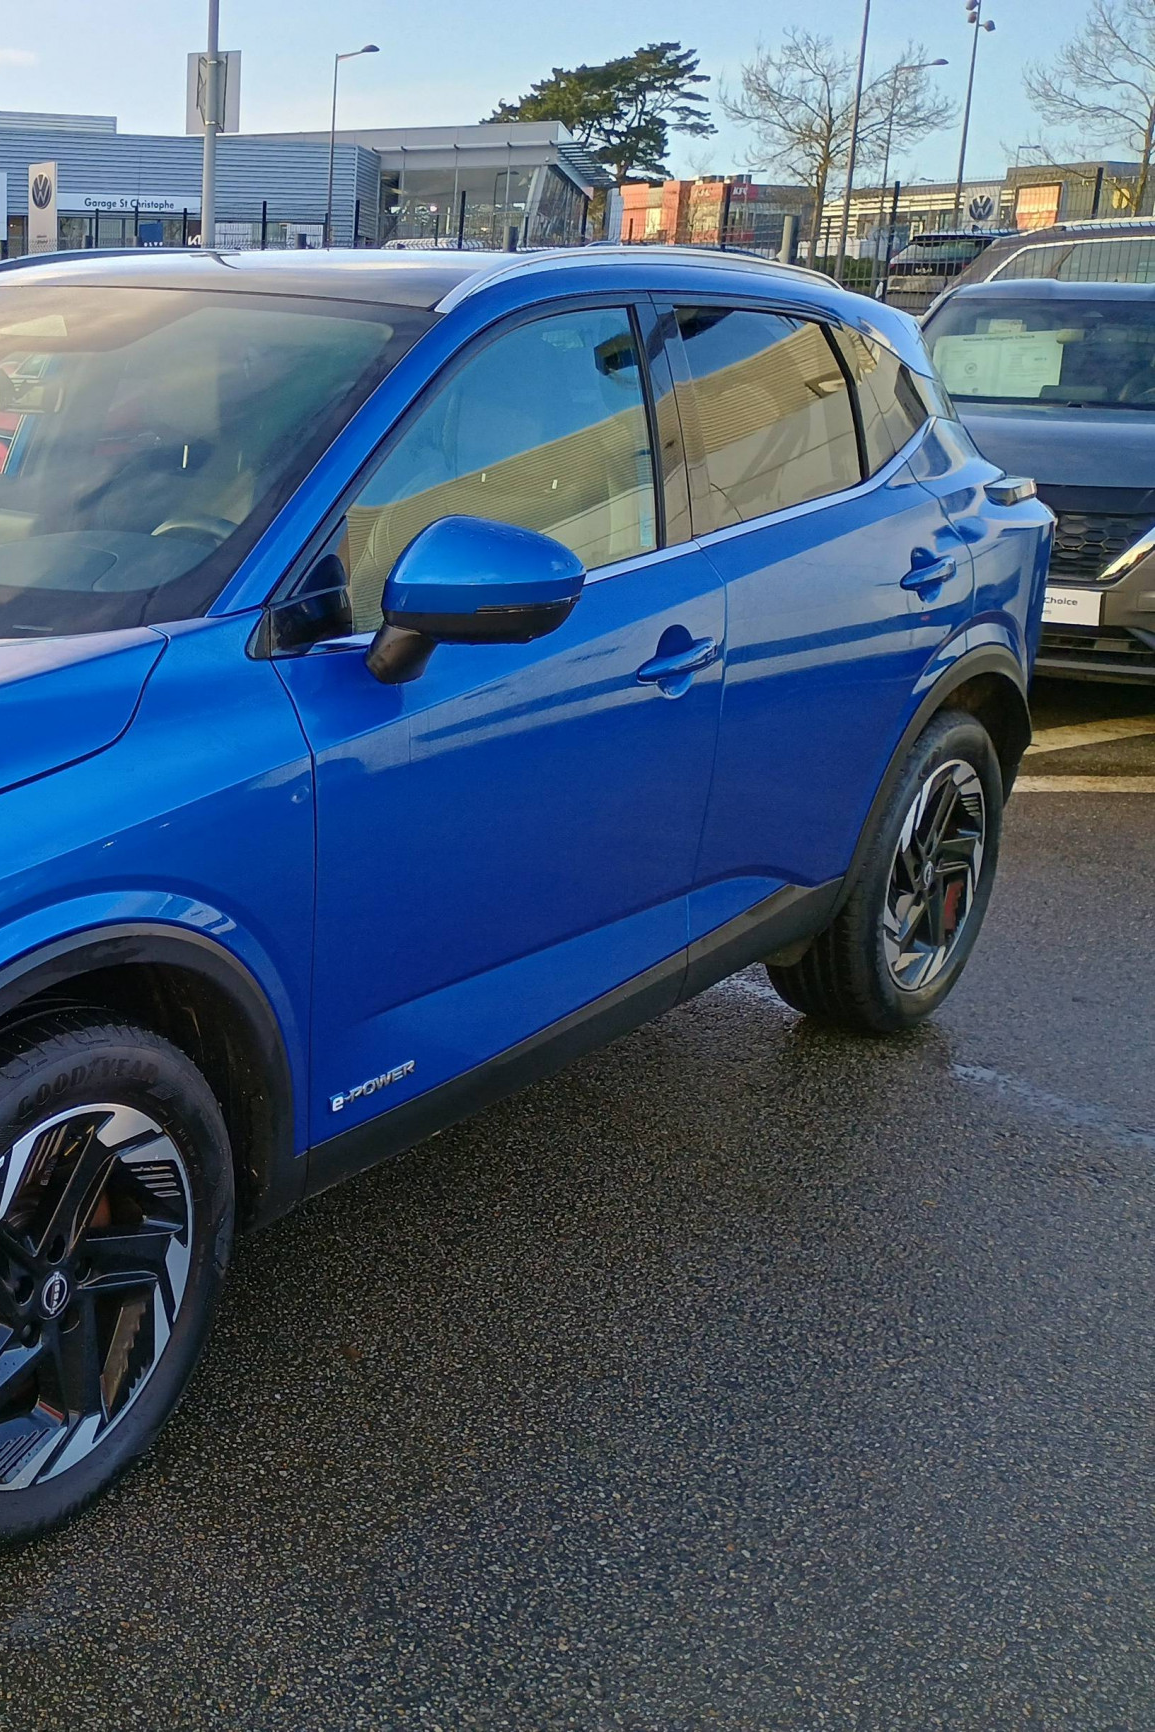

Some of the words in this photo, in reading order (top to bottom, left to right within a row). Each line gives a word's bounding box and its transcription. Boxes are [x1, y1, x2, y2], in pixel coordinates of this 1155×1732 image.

[84, 197, 117, 210] Garage
[119, 198, 128, 208] St
[130, 199, 175, 211] Christophe
[330, 1059, 416, 1113] e-POWER
